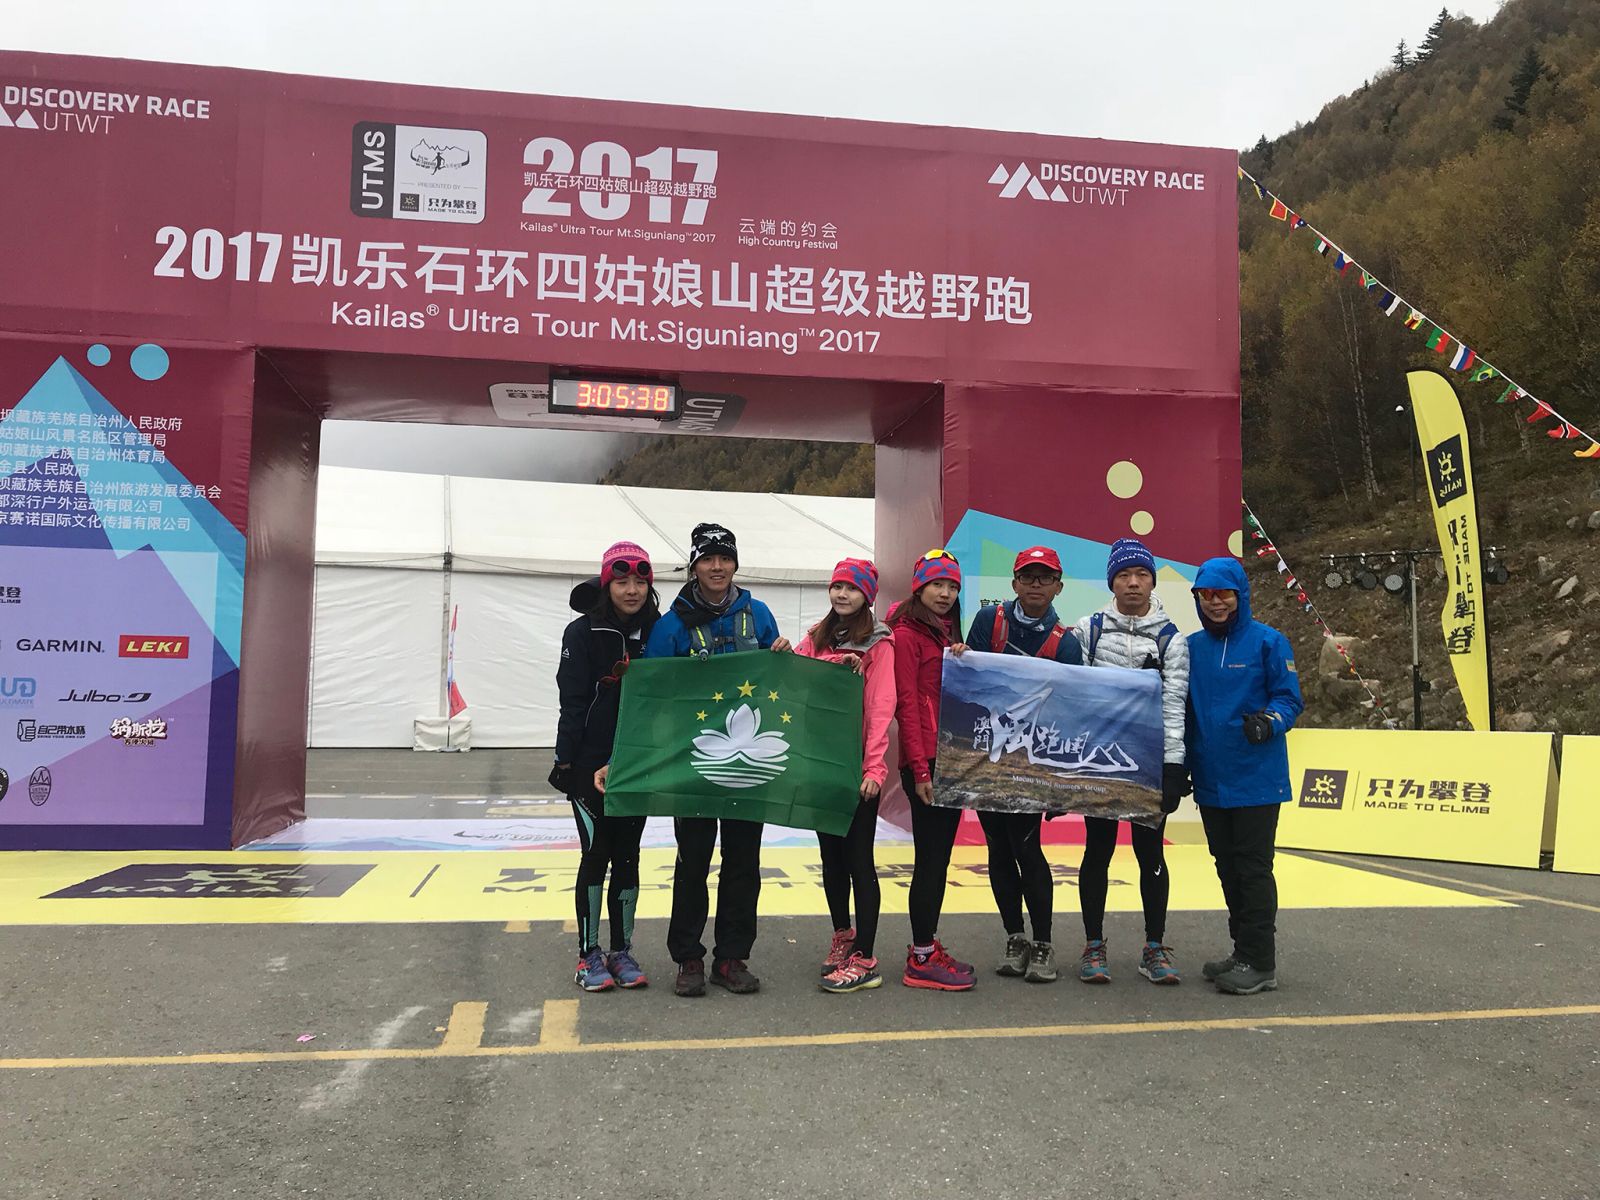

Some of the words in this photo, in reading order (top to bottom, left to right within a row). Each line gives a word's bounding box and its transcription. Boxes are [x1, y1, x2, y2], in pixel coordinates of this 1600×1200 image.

[3, 86, 140, 114] DISCOVERY
[146, 96, 211, 119] RACE
[42, 111, 115, 135] UTWT
[361, 131, 386, 210] UTMS
[522, 136, 719, 226] 2017
[1040, 162, 1150, 187] DISCOVERY
[1153, 170, 1206, 191] RACE
[523, 171, 718, 199] 凯乐石环四姑娘山超级越野跑
[1071, 186, 1130, 207] UTWT
[560, 224, 586, 235] Ultra
[590, 226, 614, 237] Tour
[738, 217, 838, 240] 云端的约会
[738, 235, 760, 248] High
[761, 236, 801, 250] Country
[802, 238, 838, 250] Festival
[448, 308, 520, 335] Ultra
[531, 312, 600, 340] Tour
[818, 329, 881, 354] 2017
[577, 381, 671, 412] 3:05:38
[126, 640, 183, 653] LEKI
[57, 689, 122, 703] Julbo
[1303, 795, 1339, 806] KAILAS
[1366, 777, 1492, 804] 只为攀登
[1364, 800, 1409, 810] MADE
[1414, 802, 1435, 811] TO
[1439, 804, 1491, 815] CLIMB
